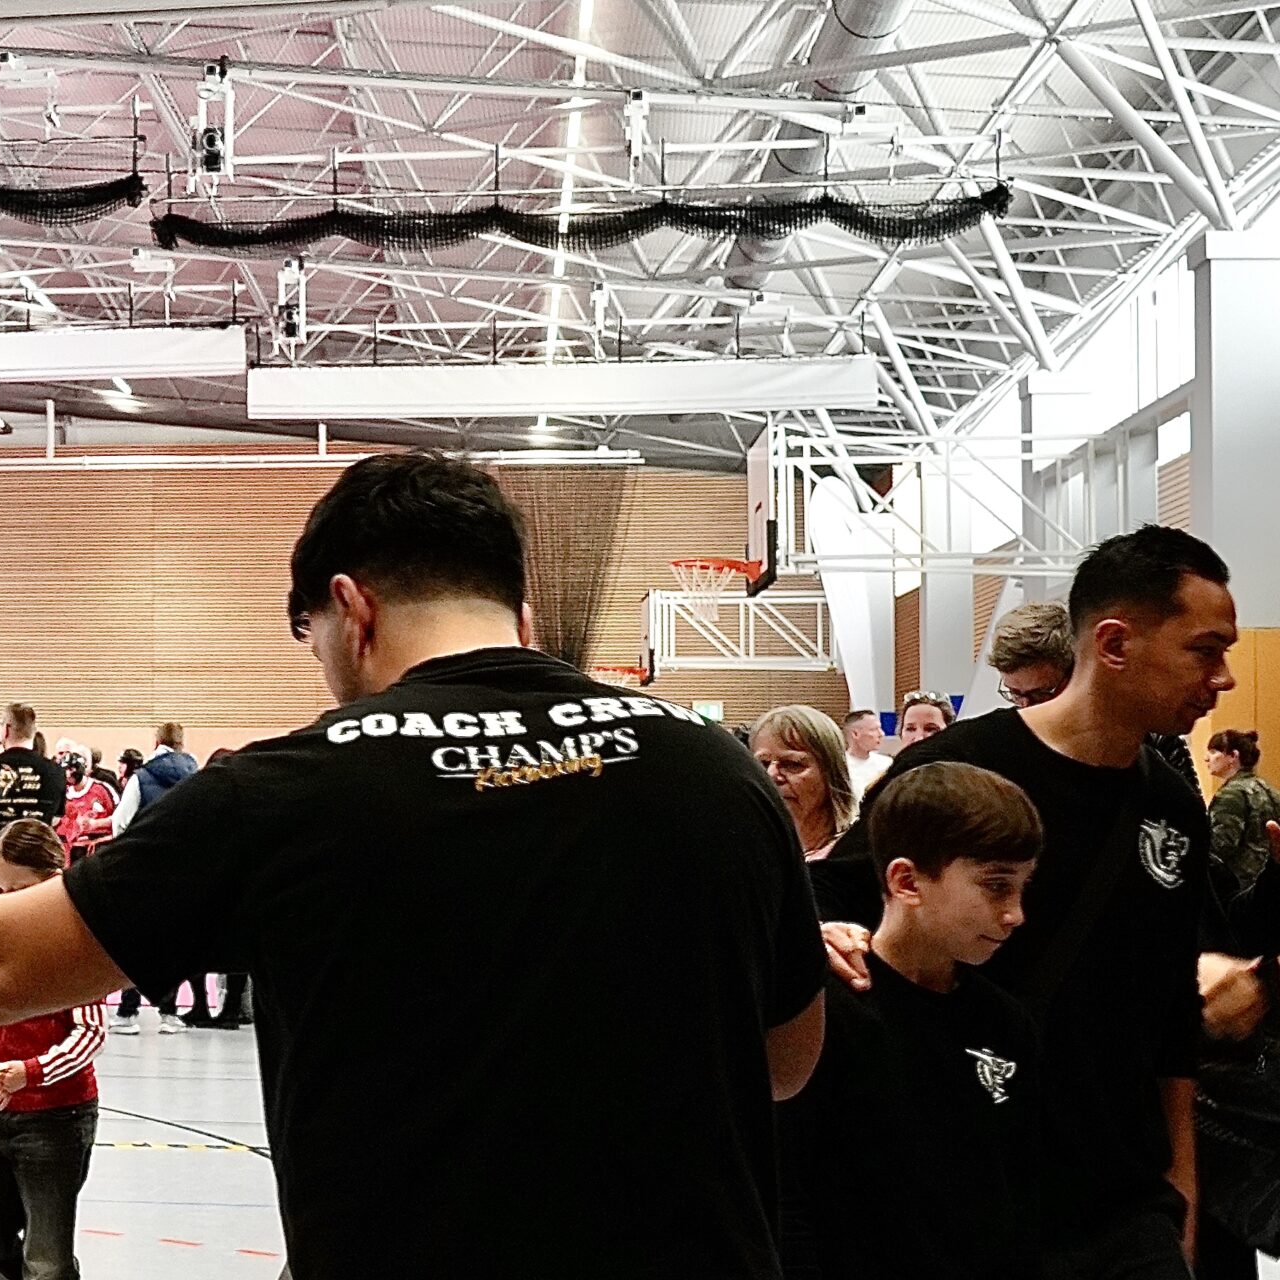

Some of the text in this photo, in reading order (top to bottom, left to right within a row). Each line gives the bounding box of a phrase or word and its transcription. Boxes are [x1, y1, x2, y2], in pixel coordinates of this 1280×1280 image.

[326, 696, 707, 744] COACH CREW
[431, 727, 640, 772] CHAMP'S
